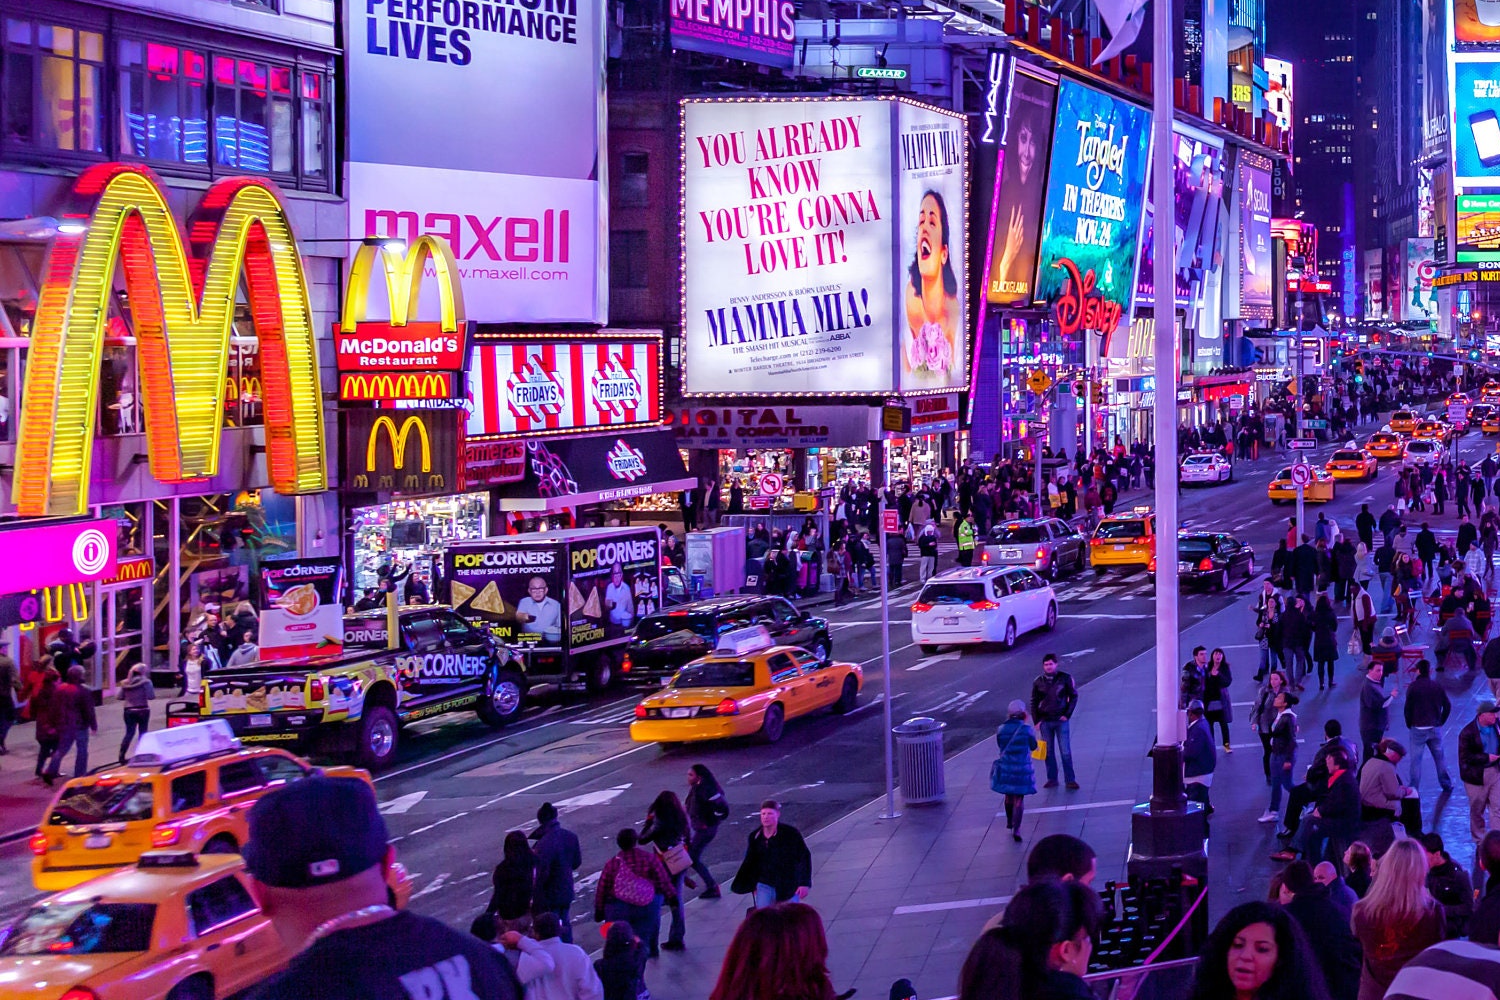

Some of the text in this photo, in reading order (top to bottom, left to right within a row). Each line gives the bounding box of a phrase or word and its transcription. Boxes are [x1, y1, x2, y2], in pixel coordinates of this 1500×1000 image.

[366, 16, 473, 67] LIVES
[861, 68, 902, 78] LAMAR
[696, 115, 862, 168] YOU ALREADY
[902, 130, 960, 170] MAMMA MIA!
[1076, 120, 1128, 190] Tangled
[748, 159, 822, 199] KNOW
[1063, 184, 1126, 222] IN THEATERS
[1253, 188, 1270, 214] SEOUL
[699, 189, 881, 243] YOU'RE GONNA
[1076, 217, 1111, 247] NOV. 24
[744, 229, 848, 276] LOVE IT!
[424, 266, 568, 281] ww.maxell.com
[751, 291, 788, 302] ANDERSSON
[992, 280, 1028, 295] BLACKGLAMA
[705, 288, 872, 347] MAMMA MIA!
[340, 336, 458, 355] McDonald's
[732, 346, 744, 354] THE
[746, 343, 768, 352] SMASH
[769, 342, 780, 350] HIT
[782, 338, 808, 348] MUSICAL
[830, 332, 851, 342] ABBA
[359, 355, 438, 368] Restaurant
[737, 426, 829, 438] COMPUTERS
[466, 441, 524, 462] ameras
[455, 552, 555, 568] POPCORNERS
[572, 542, 655, 570] POPCORNERS
[263, 565, 335, 579] POPCORNERS
[471, 568, 486, 576] NEW
[519, 566, 552, 574] POPCORN
[572, 628, 604, 644] POPCORN
[396, 654, 486, 678] POPCORNERS
